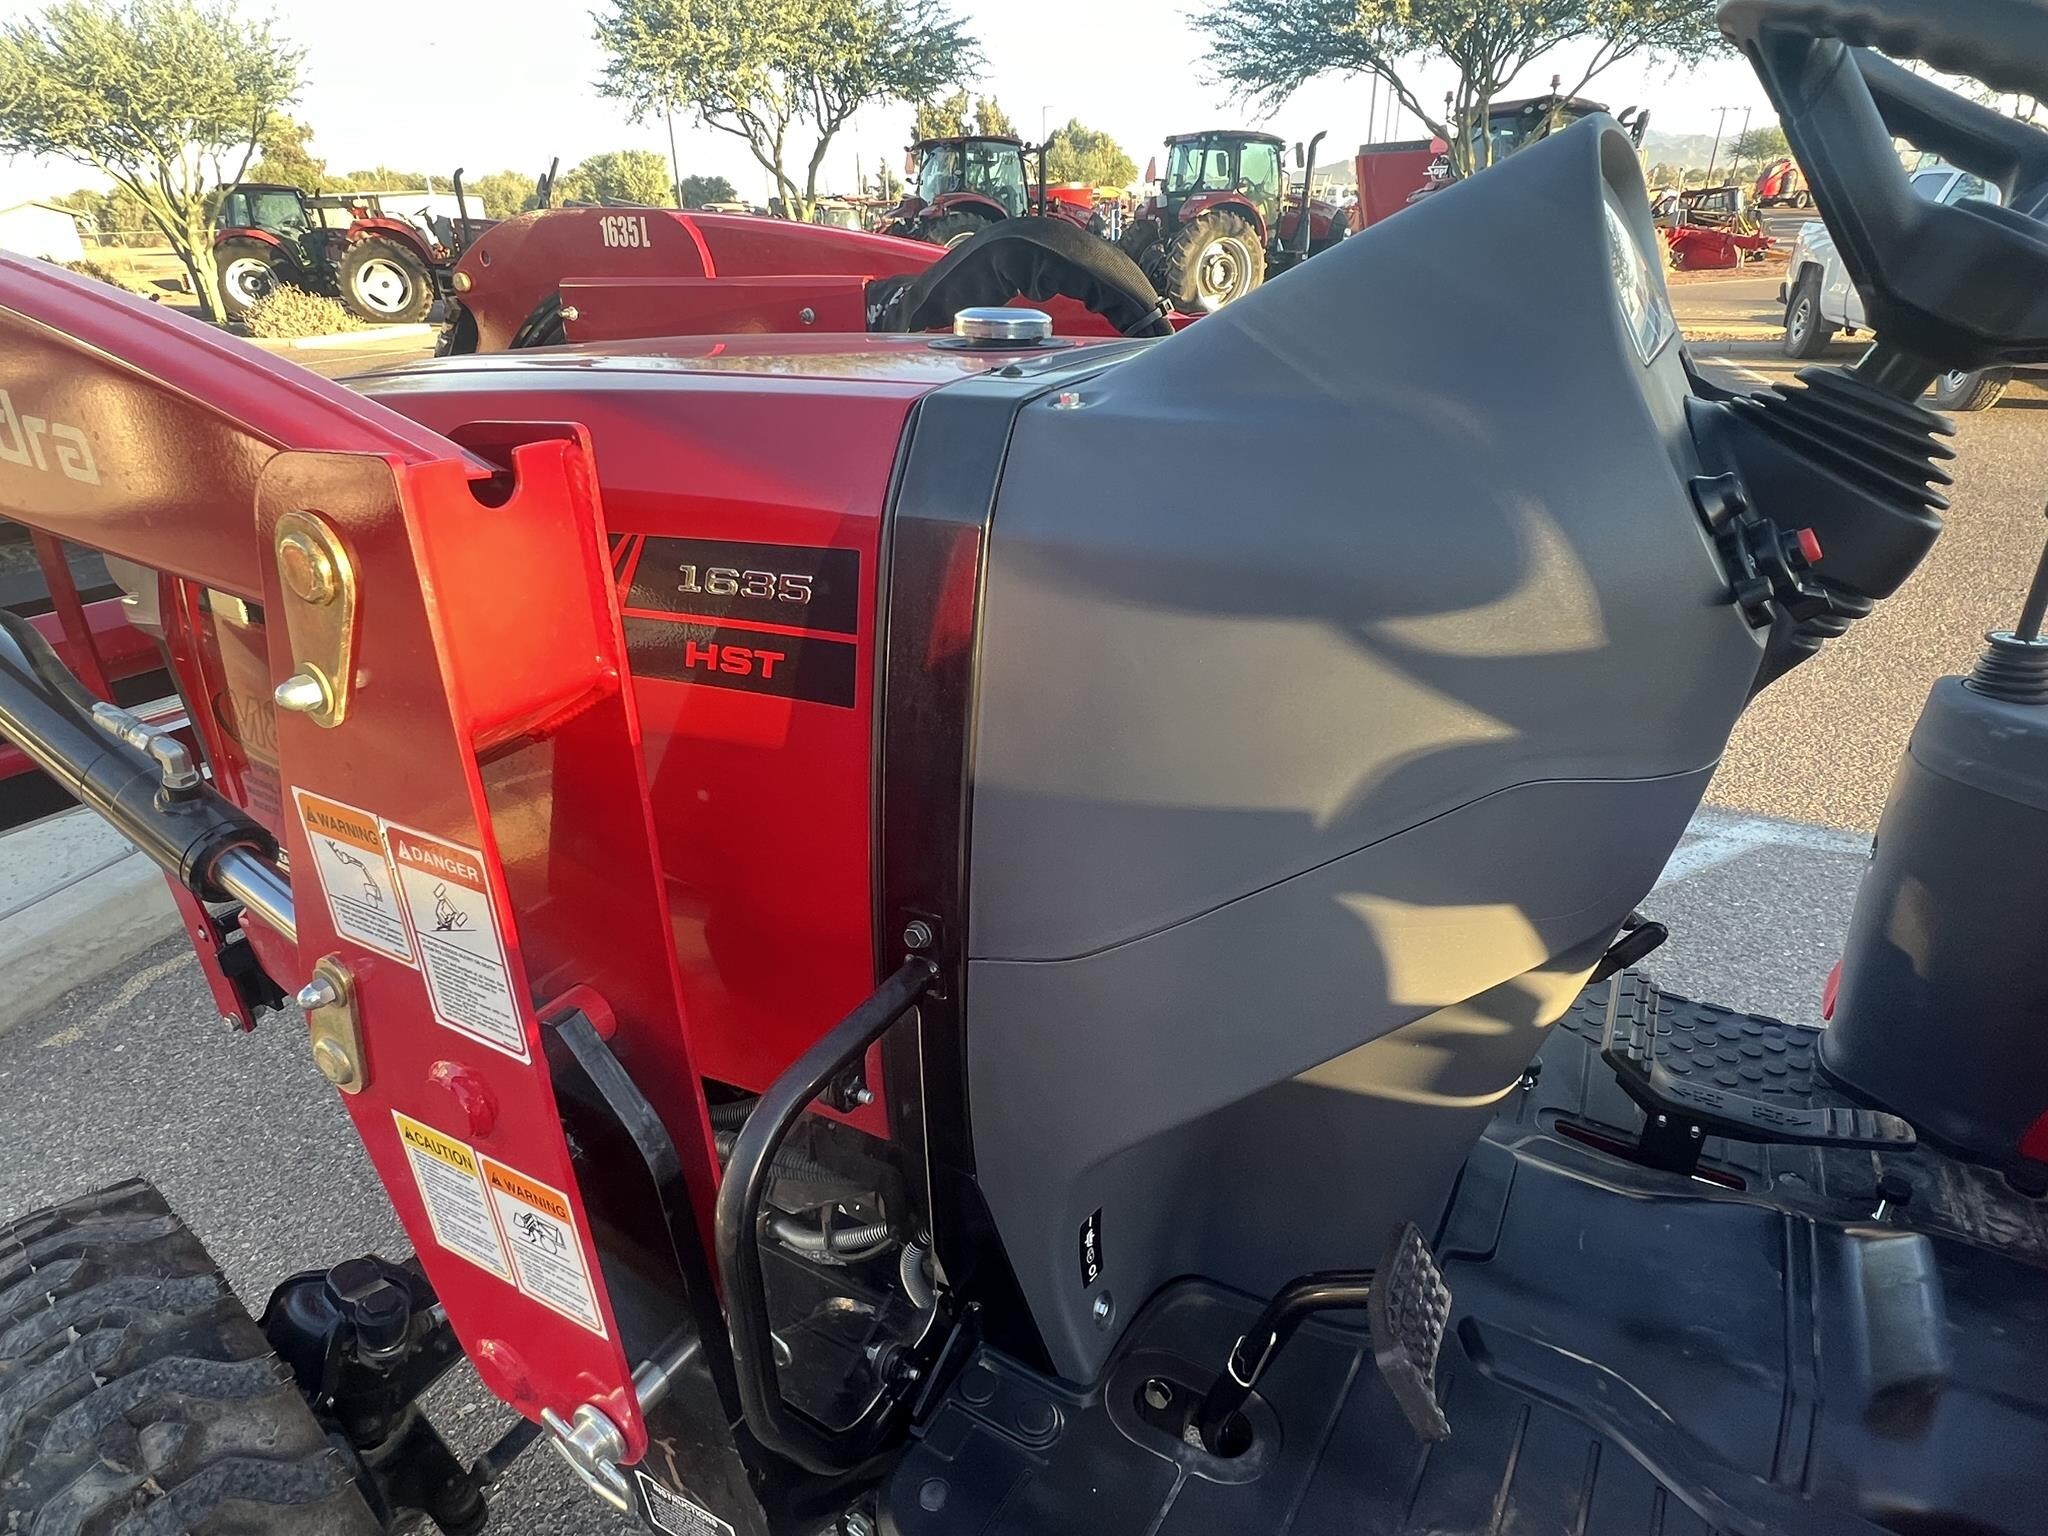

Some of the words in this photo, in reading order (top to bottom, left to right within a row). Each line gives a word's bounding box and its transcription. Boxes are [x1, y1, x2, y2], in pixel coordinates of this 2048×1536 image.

[677, 564, 813, 605] 1635
[685, 641, 785, 679] HST
[316, 811, 379, 846] WARNING
[411, 845, 480, 883] DANGER
[413, 1131, 474, 1172] CAUTION
[503, 1178, 567, 1219] WARNING
